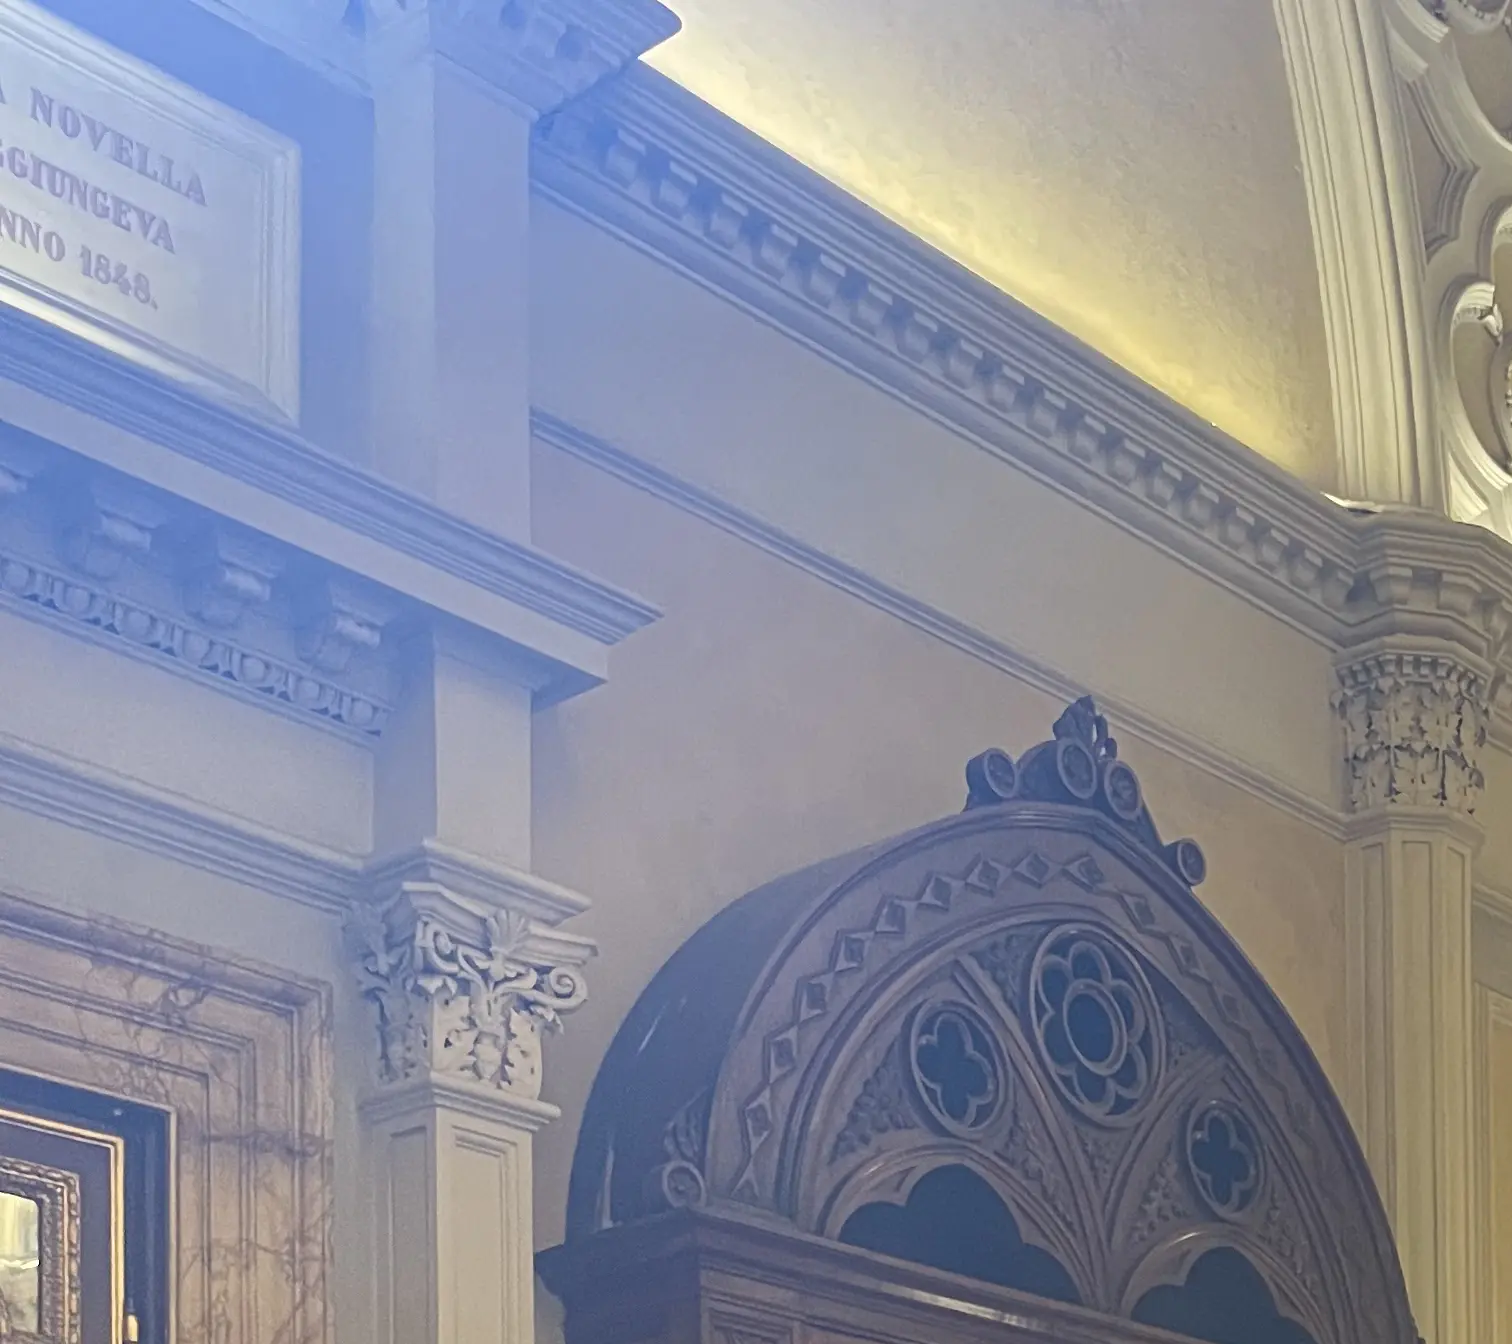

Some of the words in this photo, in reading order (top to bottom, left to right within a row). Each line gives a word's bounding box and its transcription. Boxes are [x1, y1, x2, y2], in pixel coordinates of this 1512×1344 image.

[0, 138, 175, 254] GIUNGEVA
[30, 86, 207, 207] NOVELLA
[79, 244, 158, 310] 1848.
